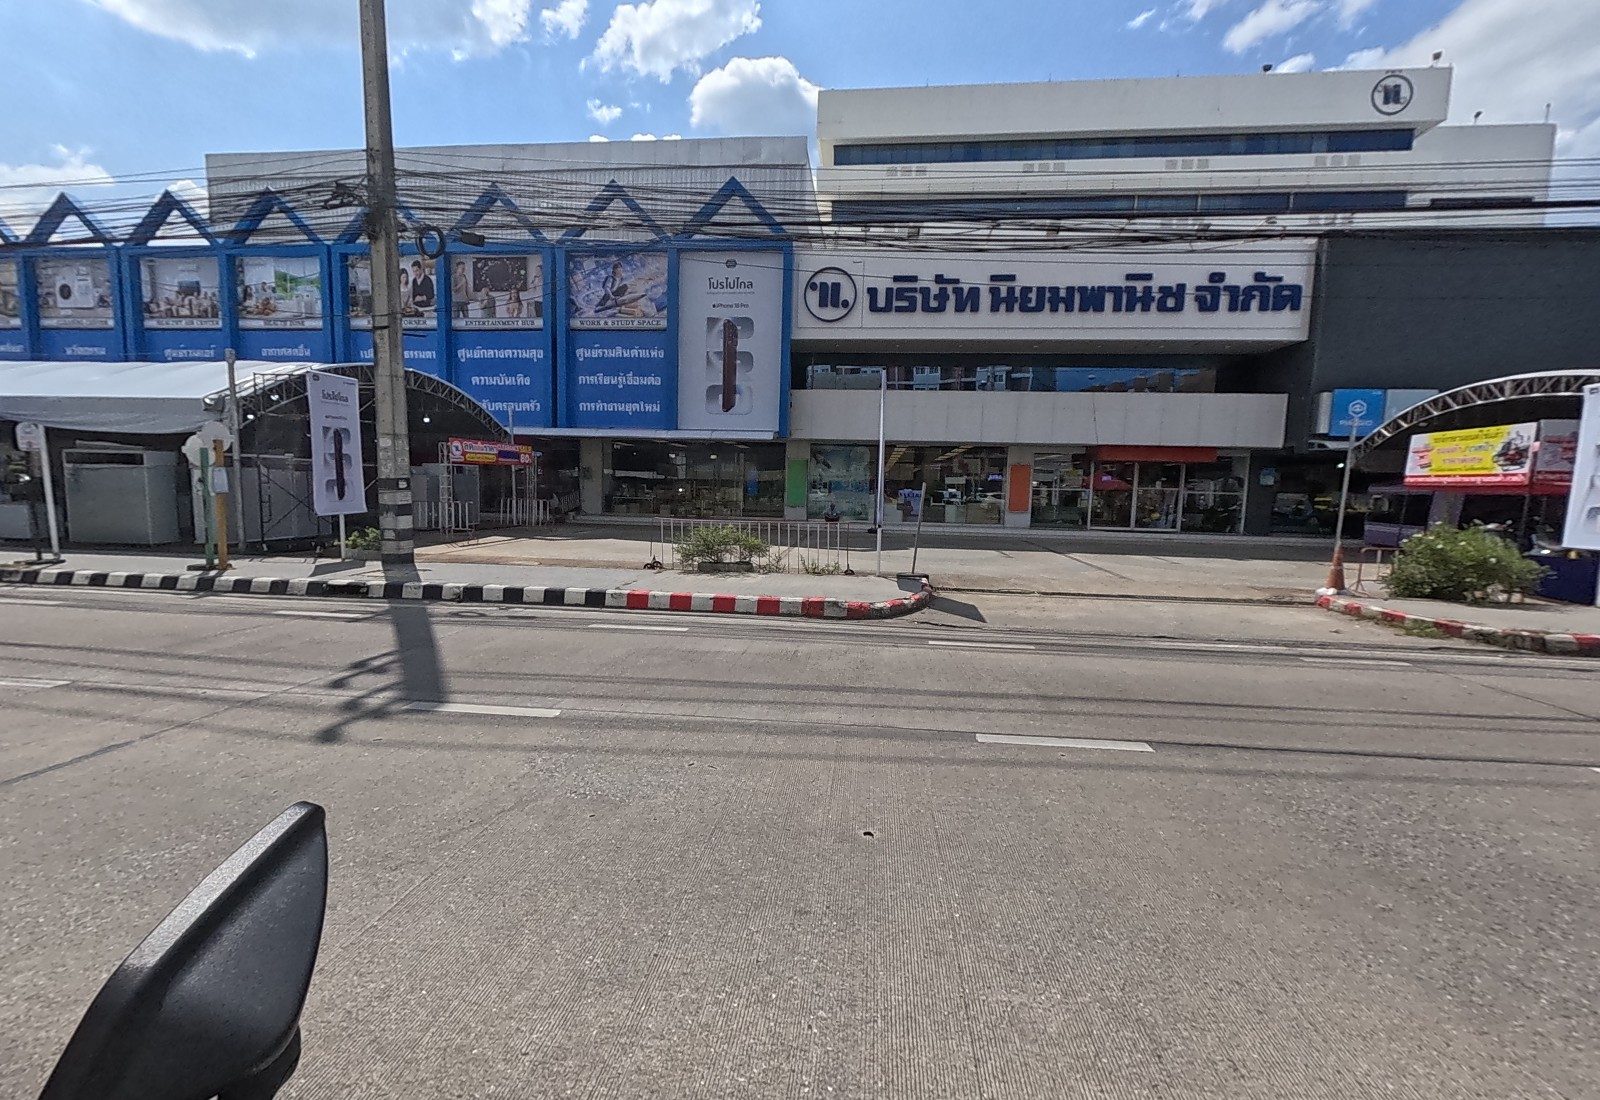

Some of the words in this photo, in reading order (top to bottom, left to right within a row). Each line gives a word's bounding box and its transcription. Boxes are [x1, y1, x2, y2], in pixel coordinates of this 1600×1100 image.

[708, 276, 754, 290] โปรไปไกล
[867, 274, 980, 313] บริษัท
[989, 273, 1187, 313] นิยมพานิช
[1195, 271, 1303, 313] จำกัด
[465, 319, 520, 327] ENTERTAINMENT
[521, 319, 536, 327] HUB
[579, 319, 602, 327] WORK
[603, 319, 609, 327] &
[611, 319, 636, 327] STUDY
[637, 319, 662, 327] SPACE
[457, 345, 544, 362] ศูนย์กลางความสุข
[575, 344, 665, 361] ศูนย์รวมสินค้าแห่ง
[471, 373, 531, 386] ความบันเทิง
[578, 400, 661, 415] การทำงานยุคใหม่
